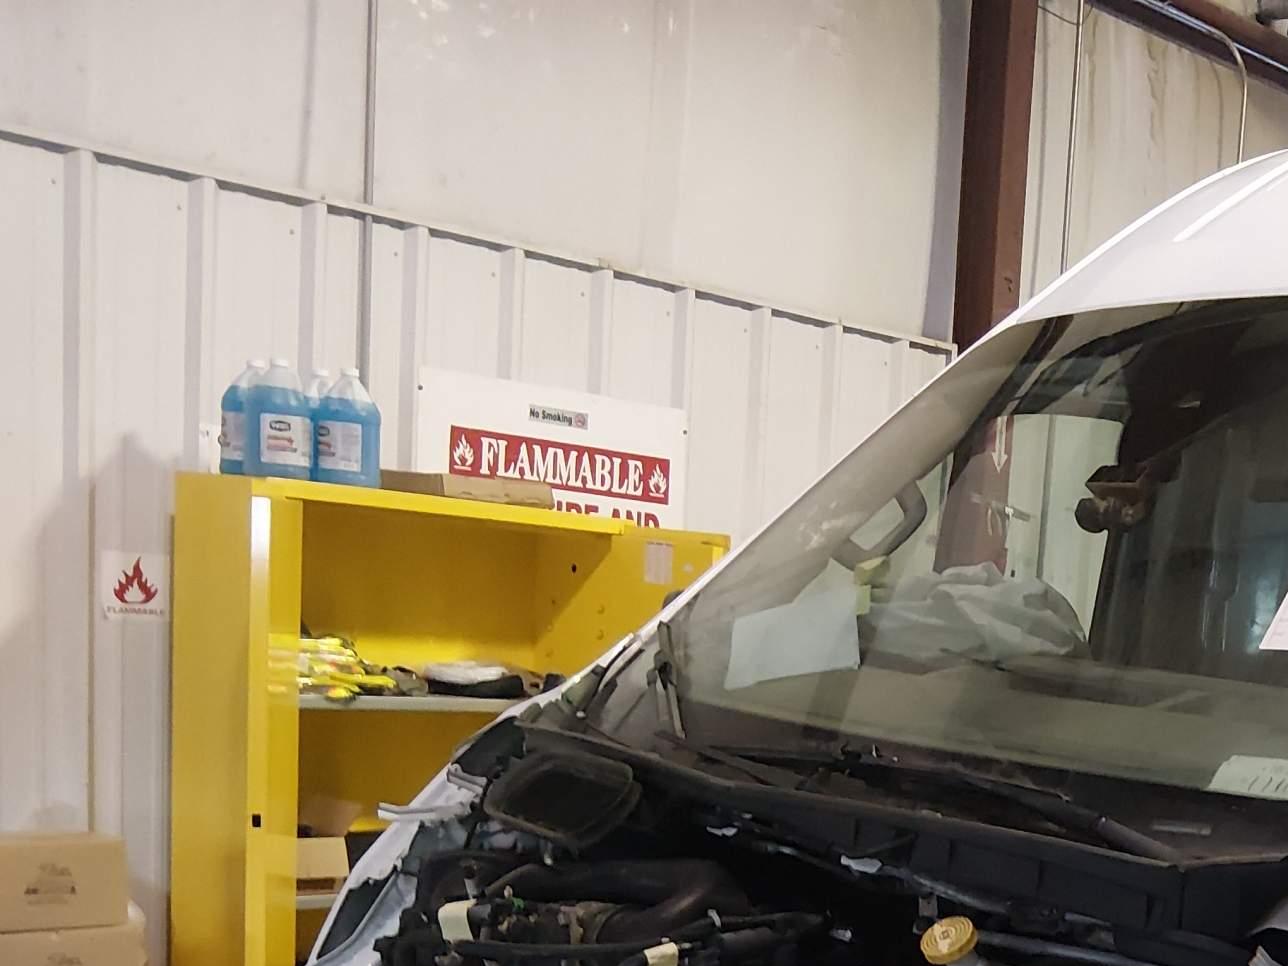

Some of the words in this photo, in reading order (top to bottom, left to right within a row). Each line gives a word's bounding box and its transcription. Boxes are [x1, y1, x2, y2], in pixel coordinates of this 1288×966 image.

[530, 407, 540, 419] No
[542, 409, 573, 427] Smoking
[479, 436, 644, 496] FLAMMABLE
